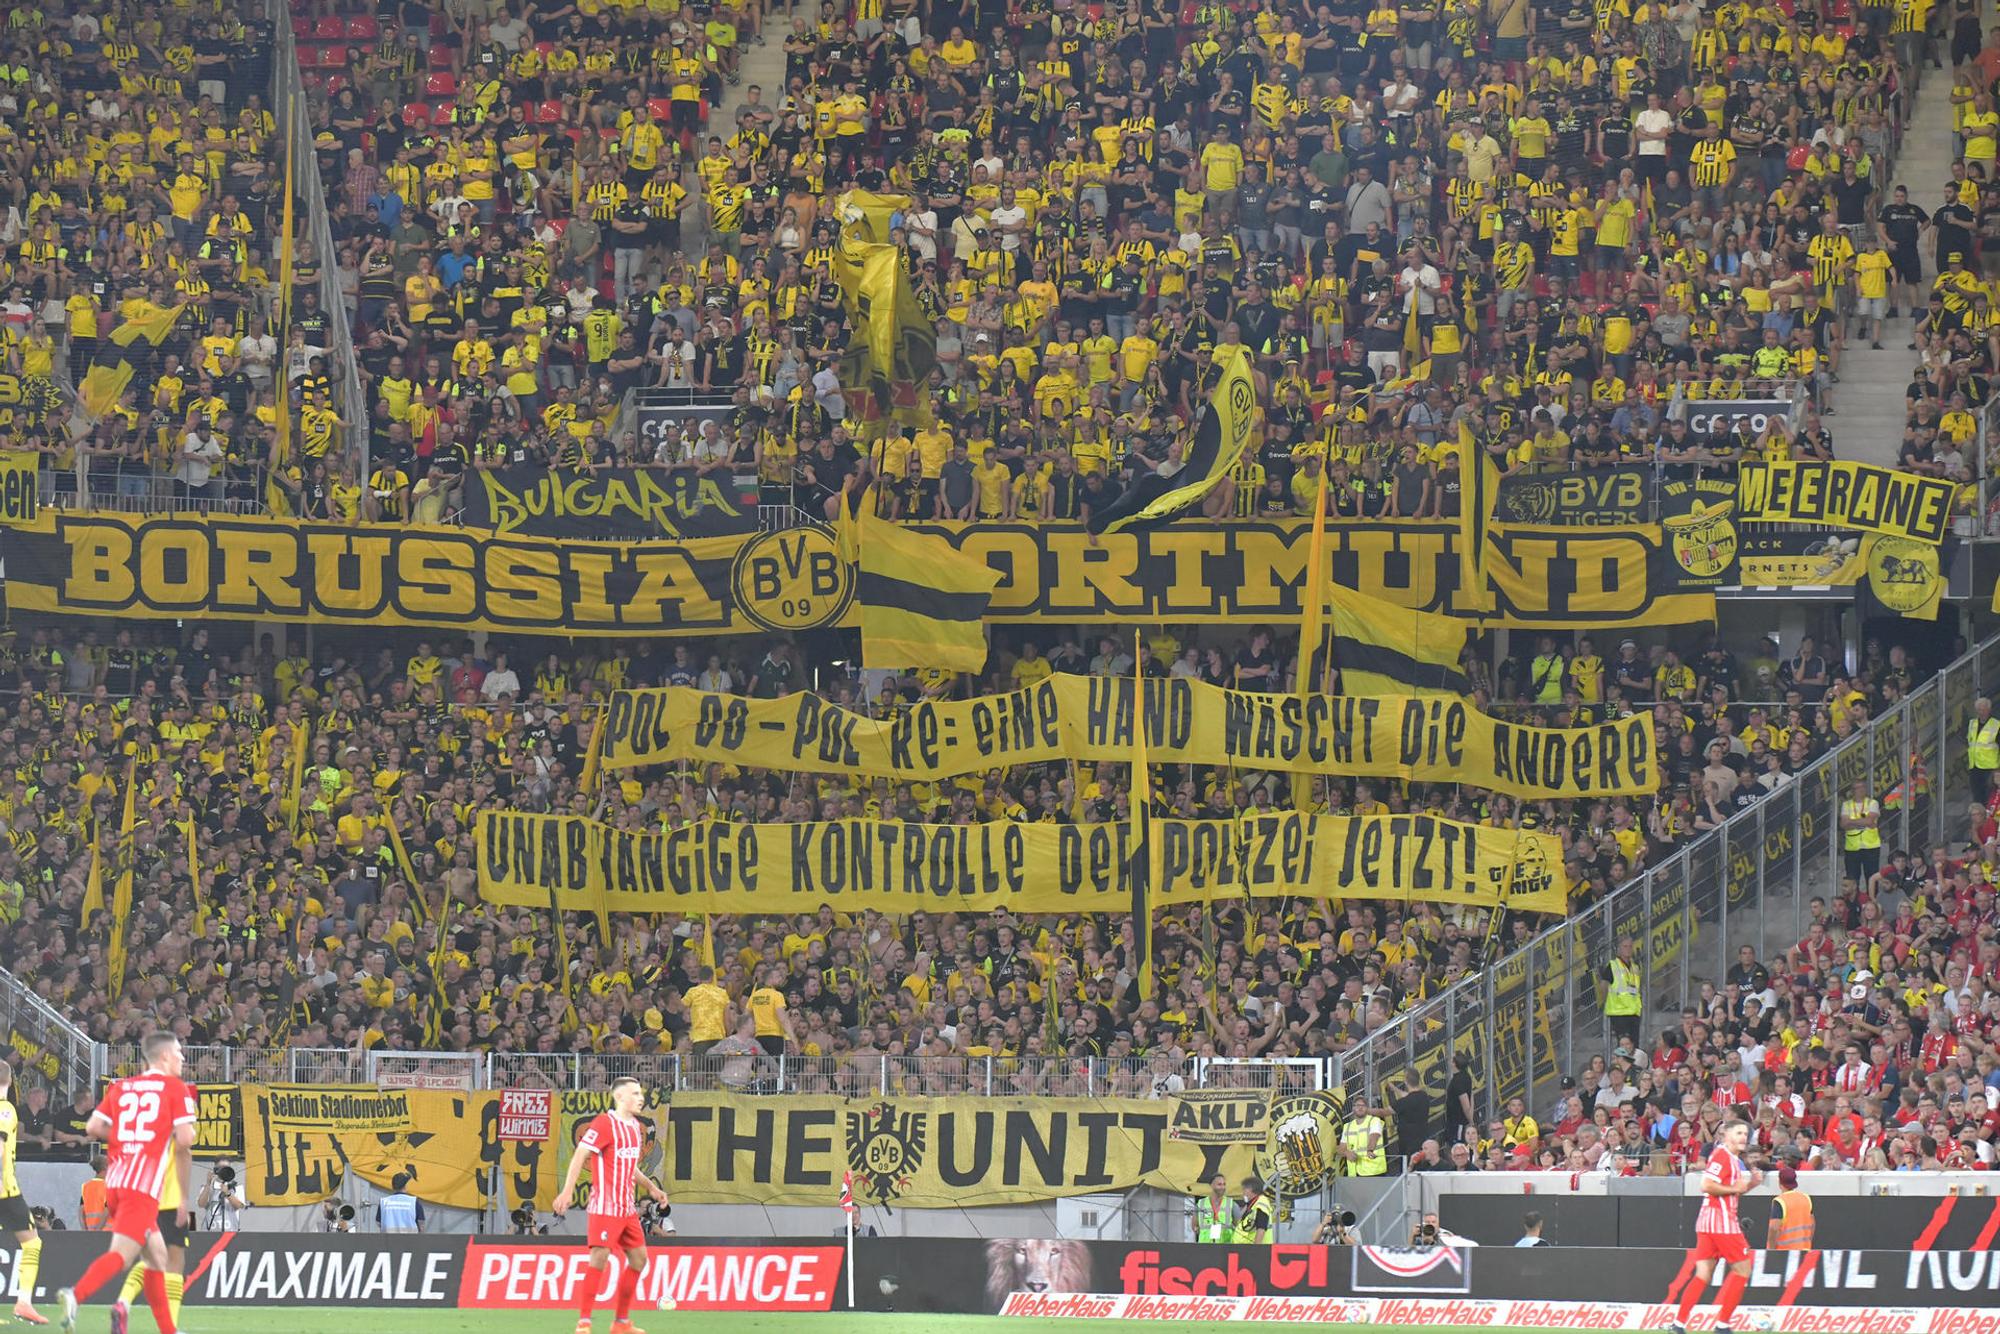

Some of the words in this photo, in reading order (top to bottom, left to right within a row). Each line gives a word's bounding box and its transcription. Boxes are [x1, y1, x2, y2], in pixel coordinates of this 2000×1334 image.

[1561, 473, 1643, 507] BVB
[1740, 464, 1949, 537] MEERANE
[64, 525, 724, 622] BORUSSIA
[753, 535, 839, 600] BVB
[912, 528, 1647, 612] ORTMUND
[781, 599, 812, 618] 09
[603, 690, 670, 758] POL
[792, 692, 860, 766] POL
[1088, 677, 1193, 750] HAND
[1225, 691, 1379, 763] WÄSCHT
[117, 1092, 161, 1142] 22
[270, 1092, 319, 1118] Sektion
[320, 1094, 409, 1119] Stadionverbot
[501, 1091, 549, 1114] FREE
[1172, 1101, 1267, 1129] AKLP
[669, 1106, 836, 1185] THE
[871, 1138, 899, 1163] BVB
[206, 1251, 452, 1299] MAXIMALE
[1006, 1293, 1116, 1318] WeberHaus
[1123, 1296, 1236, 1321] WeberHaus
[1243, 1297, 1360, 1323] WeberHau
[1375, 1299, 1498, 1326] WeberHaus
[1504, 1302, 1629, 1329] WeberHaus
[1779, 1306, 1916, 1333] WeberHaus
